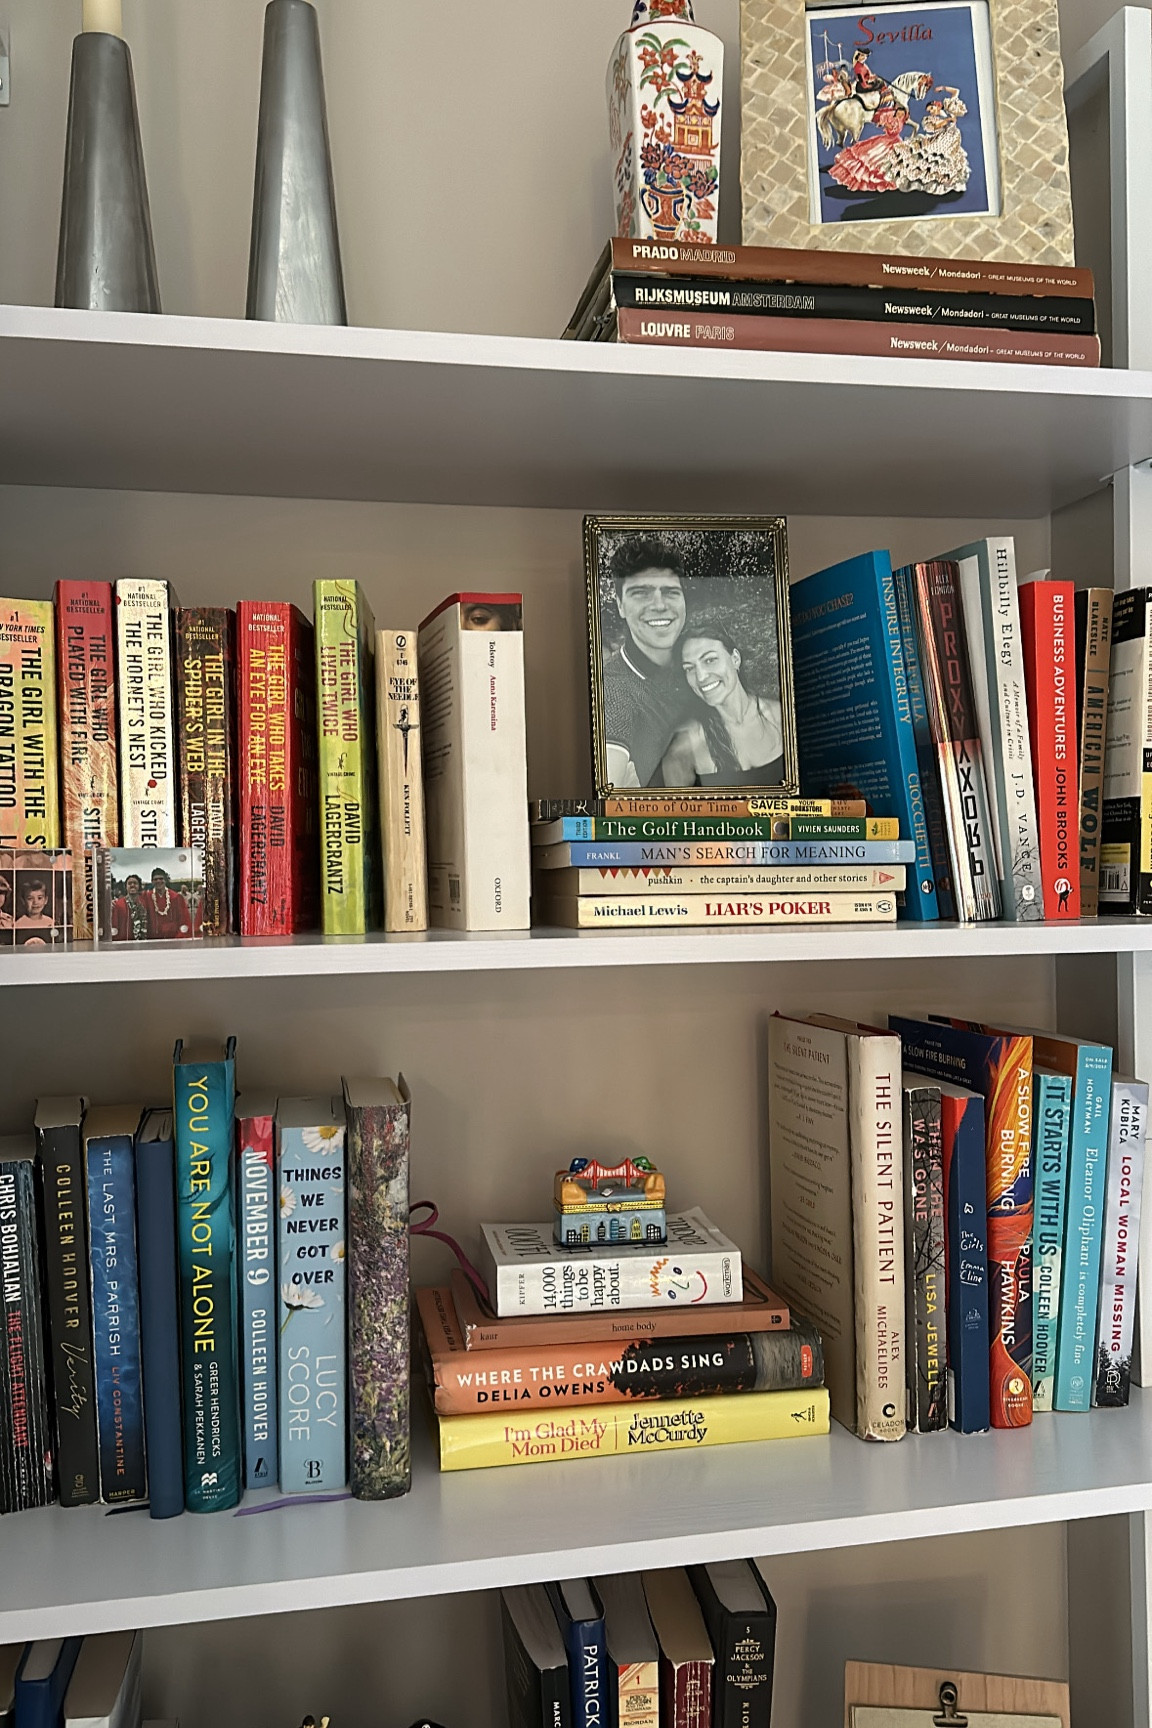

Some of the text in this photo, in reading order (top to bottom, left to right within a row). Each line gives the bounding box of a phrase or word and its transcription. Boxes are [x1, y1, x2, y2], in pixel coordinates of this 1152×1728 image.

[853, 16, 932, 46] Sevilla
[633, 245, 736, 263] PRADO MADRID
[1007, 275, 1035, 283] MUSEUMS
[635, 288, 815, 310] RIJKSMUSEUM AMSTERDAM
[641, 322, 735, 340] LOUVRE PARIS
[67, 606, 105, 614] BESTSELLER
[252, 613, 281, 622] NATIONAL
[882, 576, 899, 635] INSPIRE
[24, 626, 46, 634] TIMES
[248, 623, 285, 633] BESTSELLER
[1090, 601, 1099, 656] BLAKESLEE
[21, 647, 42, 680] THE
[1053, 594, 1066, 760] BUSINESS ADVENTURES
[125, 621, 146, 770] THE HORNET'S NEST
[146, 613, 167, 780] THE GIRL WHO KICKED
[388, 693, 419, 701] NEEDLE
[389, 677, 418, 686] EYE OF
[394, 685, 412, 693] THE
[890, 640, 912, 724] INTEGRITY
[21, 687, 43, 728] GIRL
[23, 734, 45, 779] WITH
[24, 786, 46, 819] THE
[1055, 766, 1068, 870] JOHN BROOKS
[270, 806, 285, 848] DAVID
[344, 803, 361, 845] DAVID
[603, 821, 763, 836] The Golf Handbook
[797, 825, 860, 833] VIVIEN SAUNDERS
[325, 794, 343, 895] LAGERCRANTZ
[586, 852, 621, 860] FRANKL
[641, 846, 866, 860] MAN'S SEARCH FOR MEANING
[494, 877, 502, 914] OXFORD
[648, 876, 683, 886] pushkin
[700, 873, 868, 885] the captain's daughter and other stories
[593, 904, 688, 917] Michael Lewis
[705, 901, 831, 916] LIAR'S POKER
[1017, 1068, 1030, 1178] A SLOW FIRE
[1084, 1078, 1094, 1134] HONEYMAN
[1119, 1099, 1130, 1144] KUBICA
[1131, 1105, 1141, 1140] MARY
[282, 1167, 342, 1182] THINGS
[875, 1072, 895, 1285] THE SILENT PATIENT
[1001, 1130, 1015, 1210] BURNING
[1038, 1085, 1065, 1256] IT STARTS WITH US
[188, 1076, 215, 1353] YOU ARE NOT ALONE
[300, 1193, 325, 1207] WE
[245, 1151, 270, 1286] NOVEMBER 9
[286, 1218, 339, 1234] NEVER
[961, 1231, 974, 1239] The
[56, 1164, 79, 1328] COLLEEN HOOVER
[297, 1245, 329, 1259] GOT
[1073, 1148, 1098, 1365] Eleanor Oliphant is completely fine
[1111, 1156, 1132, 1352] LOCAL WOMAN MISSING
[291, 1270, 334, 1285] OVER
[560, 1264, 576, 1309] things
[590, 1264, 605, 1307] happy
[1018, 1244, 1030, 1303] PAULA
[1001, 1260, 1016, 1346] HAWKINS
[1034, 1266, 1052, 1373] COLLEEN HOOVER
[480, 1332, 498, 1341] kaur
[612, 1321, 657, 1332] home body
[925, 1274, 939, 1391] LISA JEWELL
[876, 1305, 888, 1389] MICHAELIDES
[891, 1331, 899, 1361] ALEX
[60, 1341, 88, 1420] Verity
[251, 1309, 268, 1441] COLLEEN HOOVER
[457, 1353, 724, 1388] WHERE THE CRAWDADS SING
[194, 1373, 203, 1409] SARAH
[288, 1346, 311, 1441] SCORE
[315, 1355, 337, 1427] LUCY
[477, 1382, 606, 1403] DELIA OWENS
[209, 1362, 221, 1457] GREER HENDRICKS
[629, 1410, 705, 1431] Jennette
[195, 1411, 206, 1465] PEKKANEN
[511, 1435, 601, 1458] Mom Died
[628, 1425, 708, 1446] McCurdy
[109, 1489, 136, 1498] HARPER
[731, 1653, 765, 1661] JACKSON
[735, 1645, 760, 1653] PERCY
[583, 1644, 600, 1728] PATRICK
[727, 1674, 767, 1682] OLYMPIANS
[623, 1719, 653, 1727] RIORDAN
